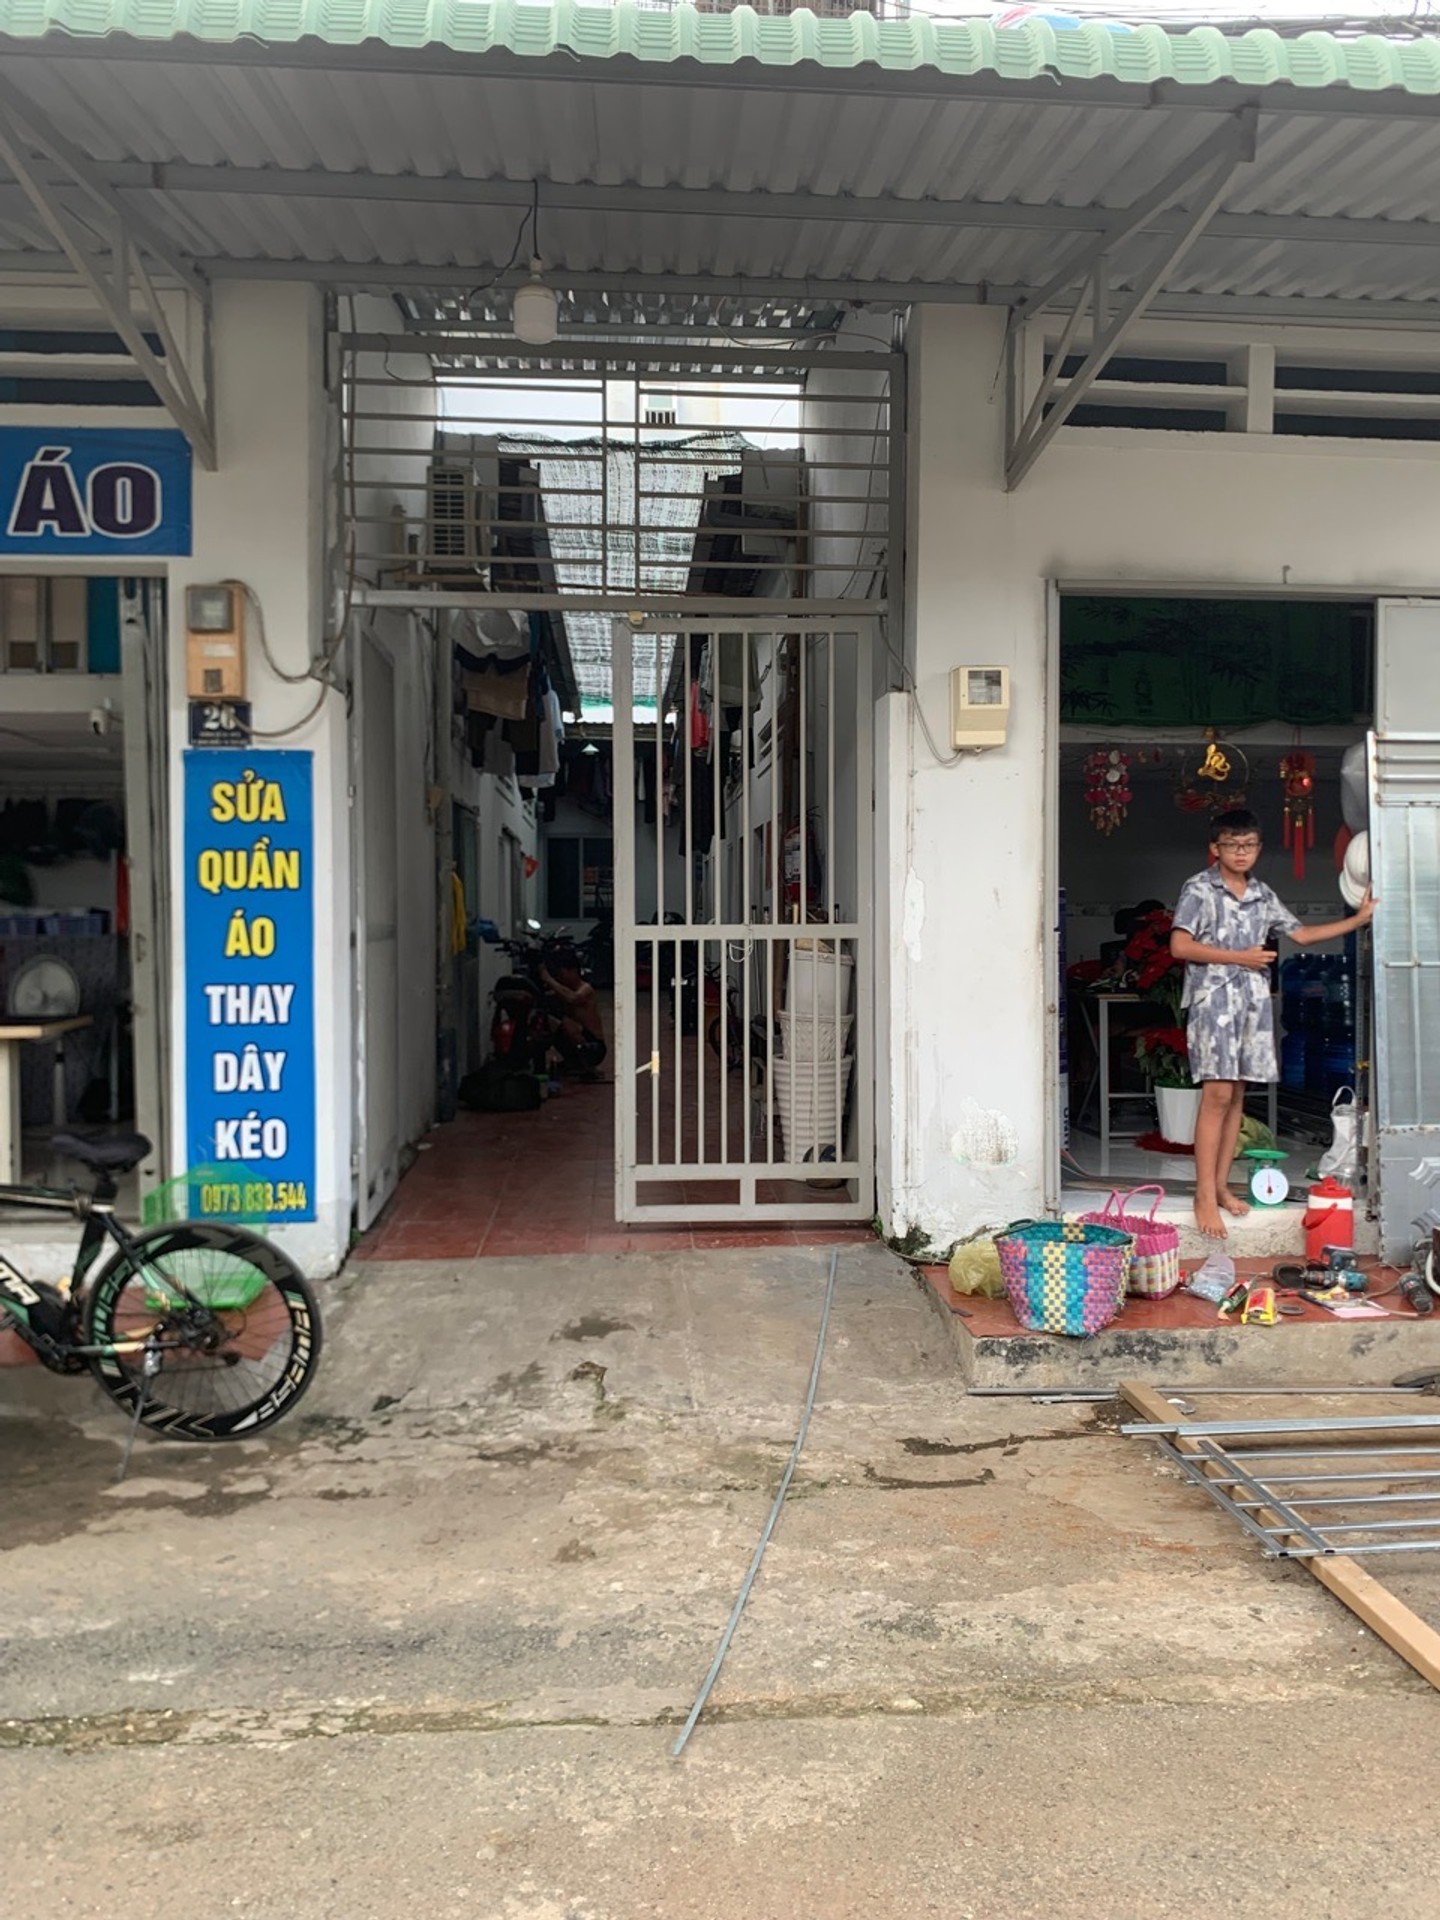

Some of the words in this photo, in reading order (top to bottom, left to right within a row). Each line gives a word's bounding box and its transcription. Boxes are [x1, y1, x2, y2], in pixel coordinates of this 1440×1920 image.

[7, 446, 163, 539] ÁO
[211, 770, 286, 822] SỬA
[199, 837, 299, 894] QUẦN
[225, 909, 275, 957] ÁO
[204, 984, 294, 1025] THAY
[214, 1044, 286, 1092] DÂY
[215, 1111, 287, 1160] KÉO
